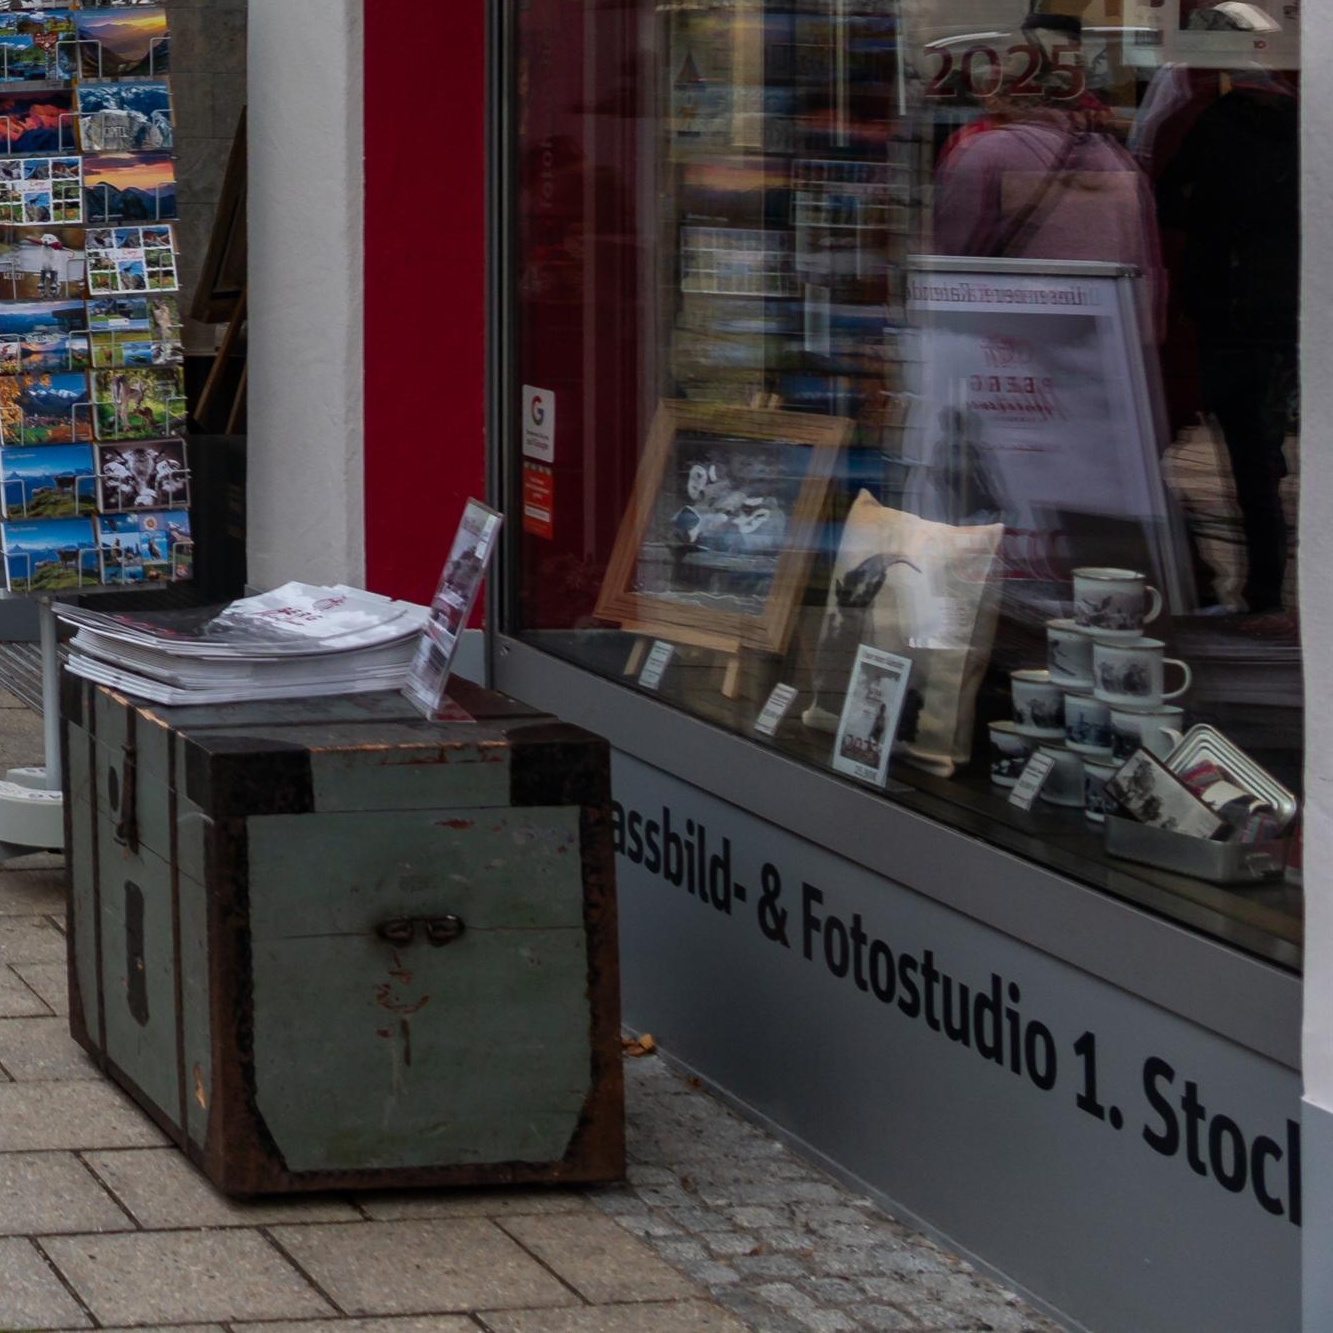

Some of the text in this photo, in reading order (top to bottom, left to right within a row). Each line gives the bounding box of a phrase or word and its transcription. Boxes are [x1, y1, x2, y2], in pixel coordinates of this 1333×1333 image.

[924, 44, 1086, 100] 2025
[612, 800, 746, 916] assbild-
[757, 862, 790, 949] &
[802, 881, 1057, 1091] Fotostudio
[1073, 1030, 1123, 1131] 1.
